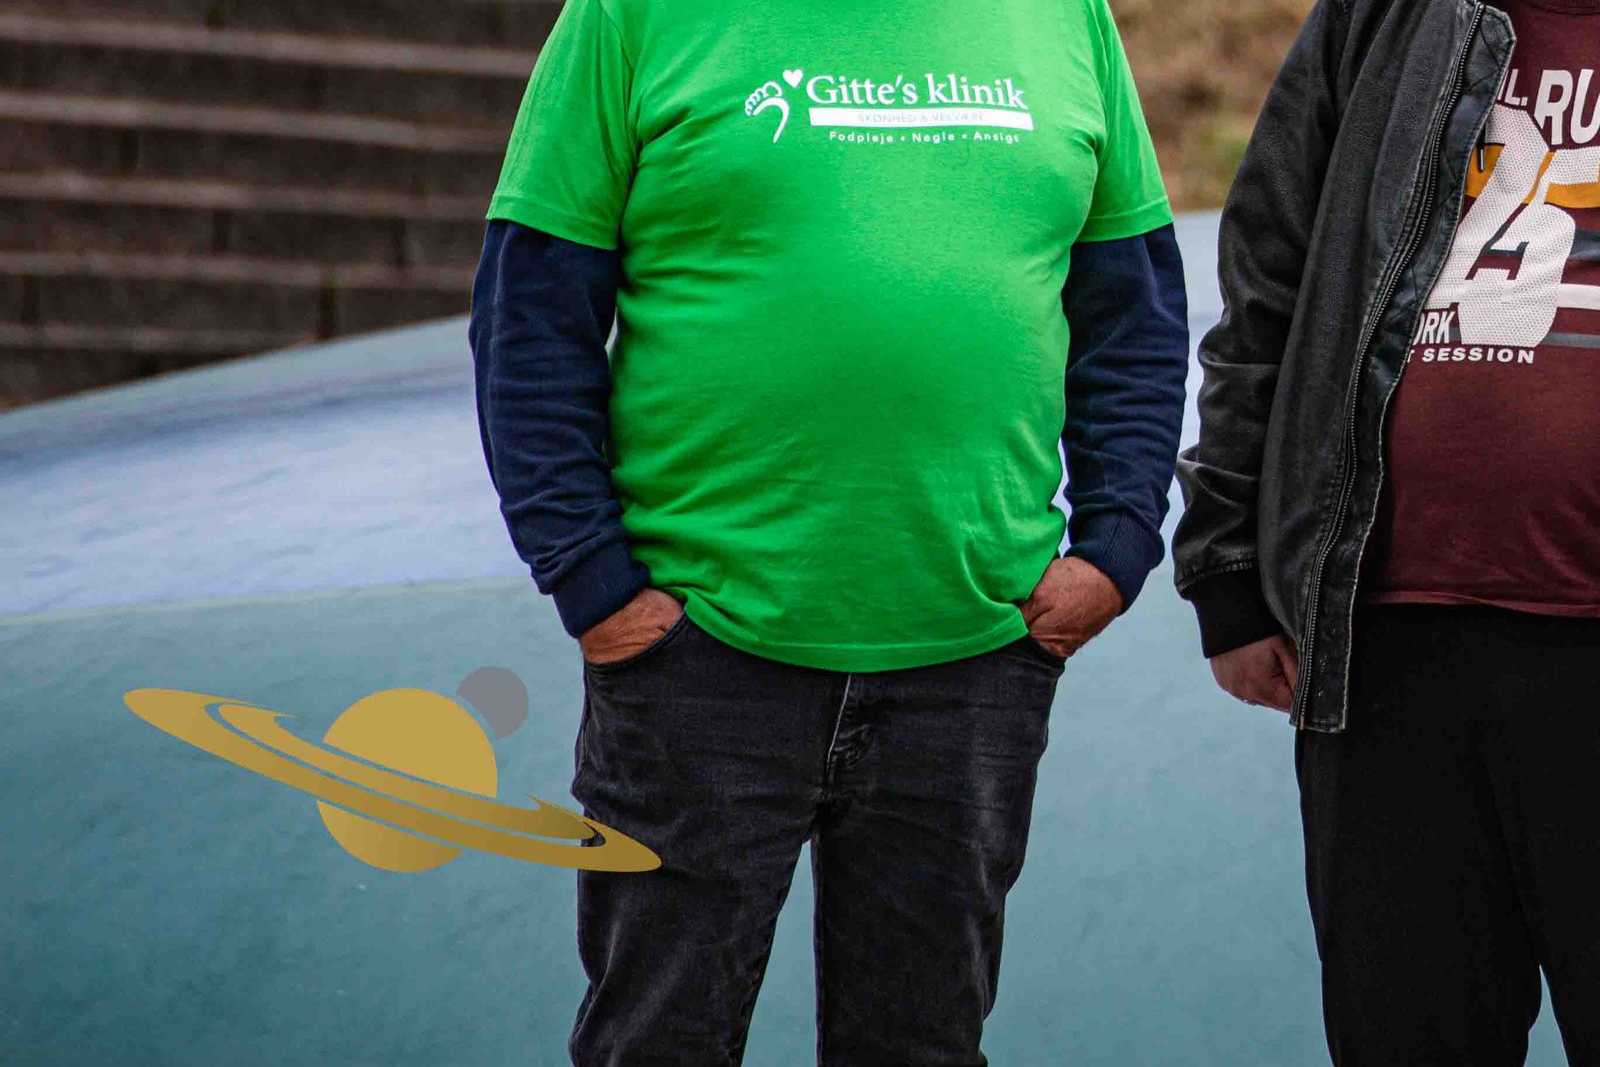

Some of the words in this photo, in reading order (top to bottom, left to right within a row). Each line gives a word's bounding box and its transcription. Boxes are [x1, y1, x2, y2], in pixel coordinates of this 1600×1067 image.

[806, 75, 918, 106] Gitte's
[925, 73, 1028, 110] klinik
[829, 131, 894, 144] Fodpleje
[912, 131, 955, 144] Negle
[973, 131, 1020, 144] Ansigt
[1422, 347, 1535, 364] SESSION
